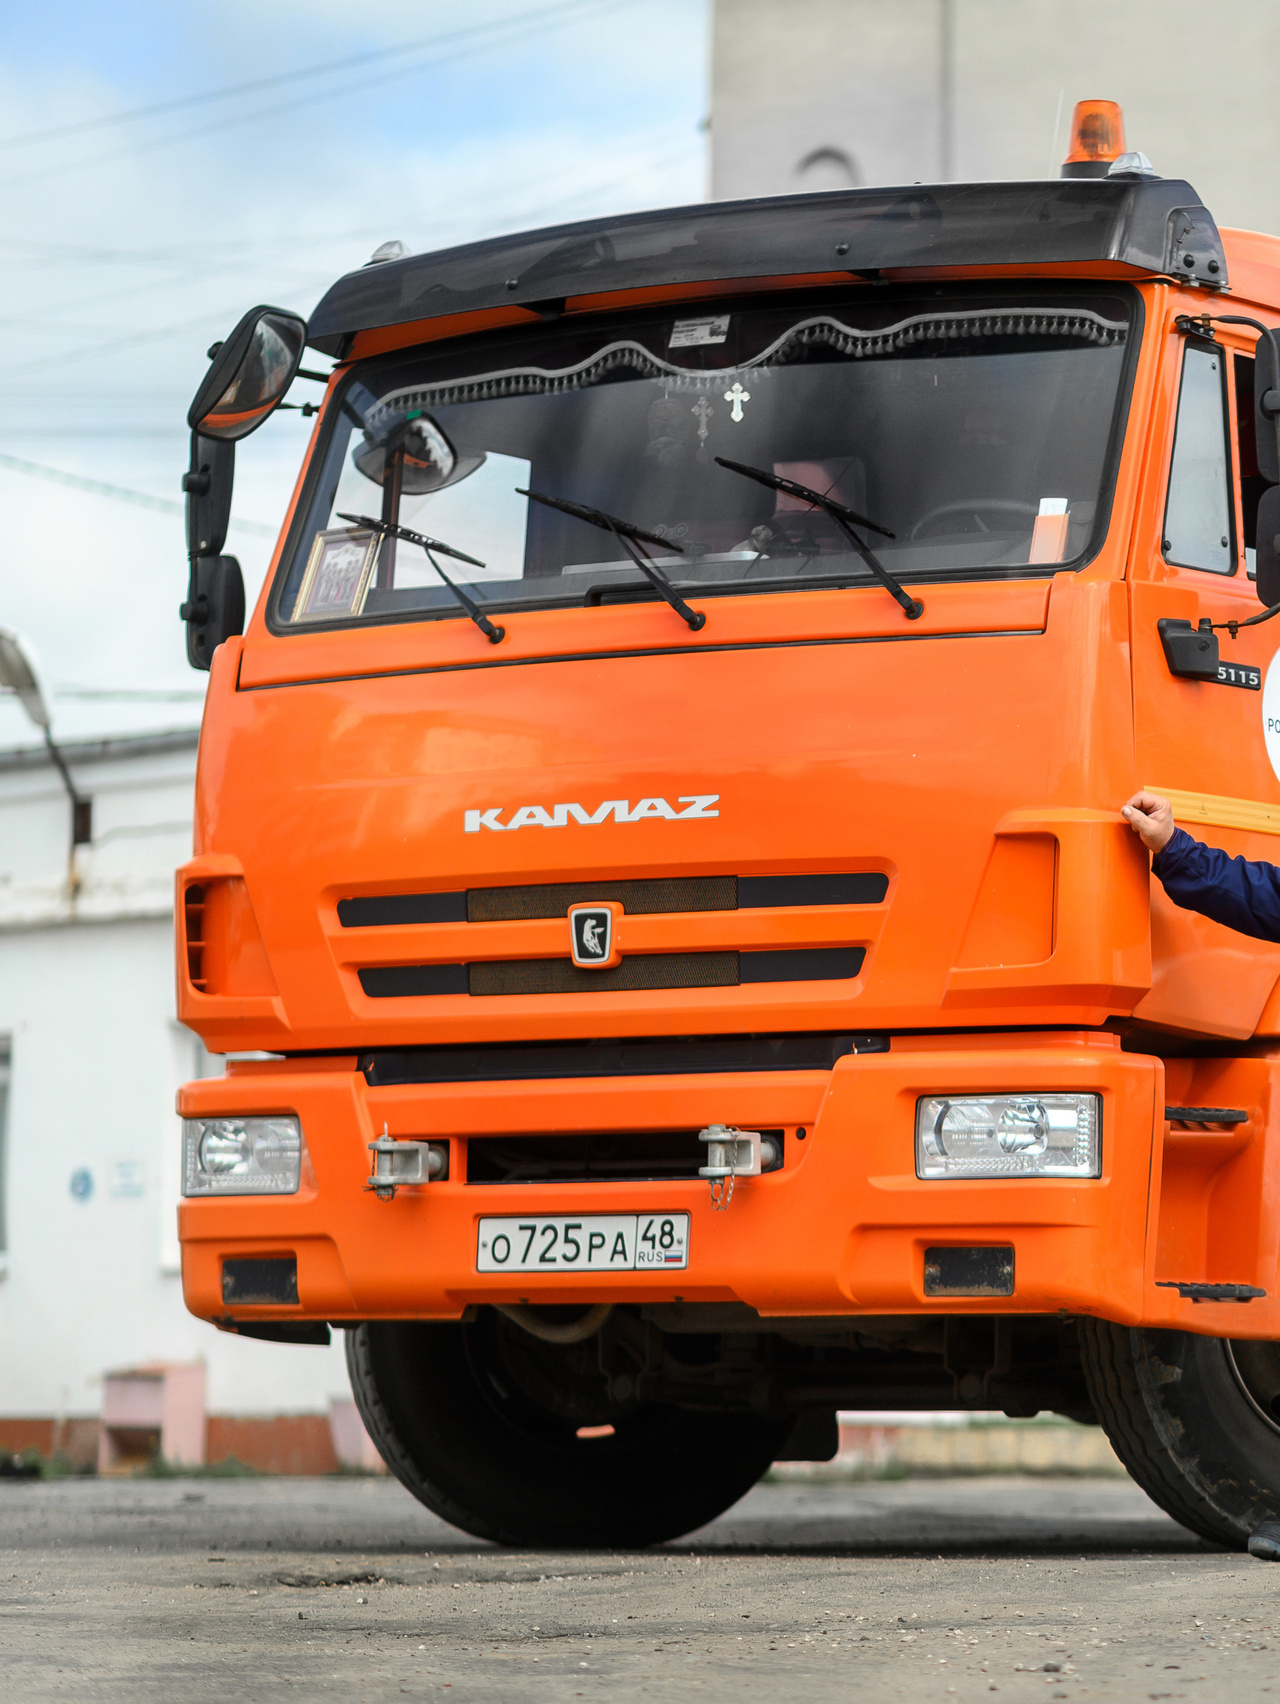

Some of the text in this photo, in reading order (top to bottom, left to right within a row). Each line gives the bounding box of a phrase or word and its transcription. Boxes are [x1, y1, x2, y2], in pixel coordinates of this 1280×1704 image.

[1217, 666, 1259, 685] 5115
[464, 794, 720, 833] KAMAZ
[642, 1218, 675, 1249] 48
[638, 1251, 663, 1262] RUS
